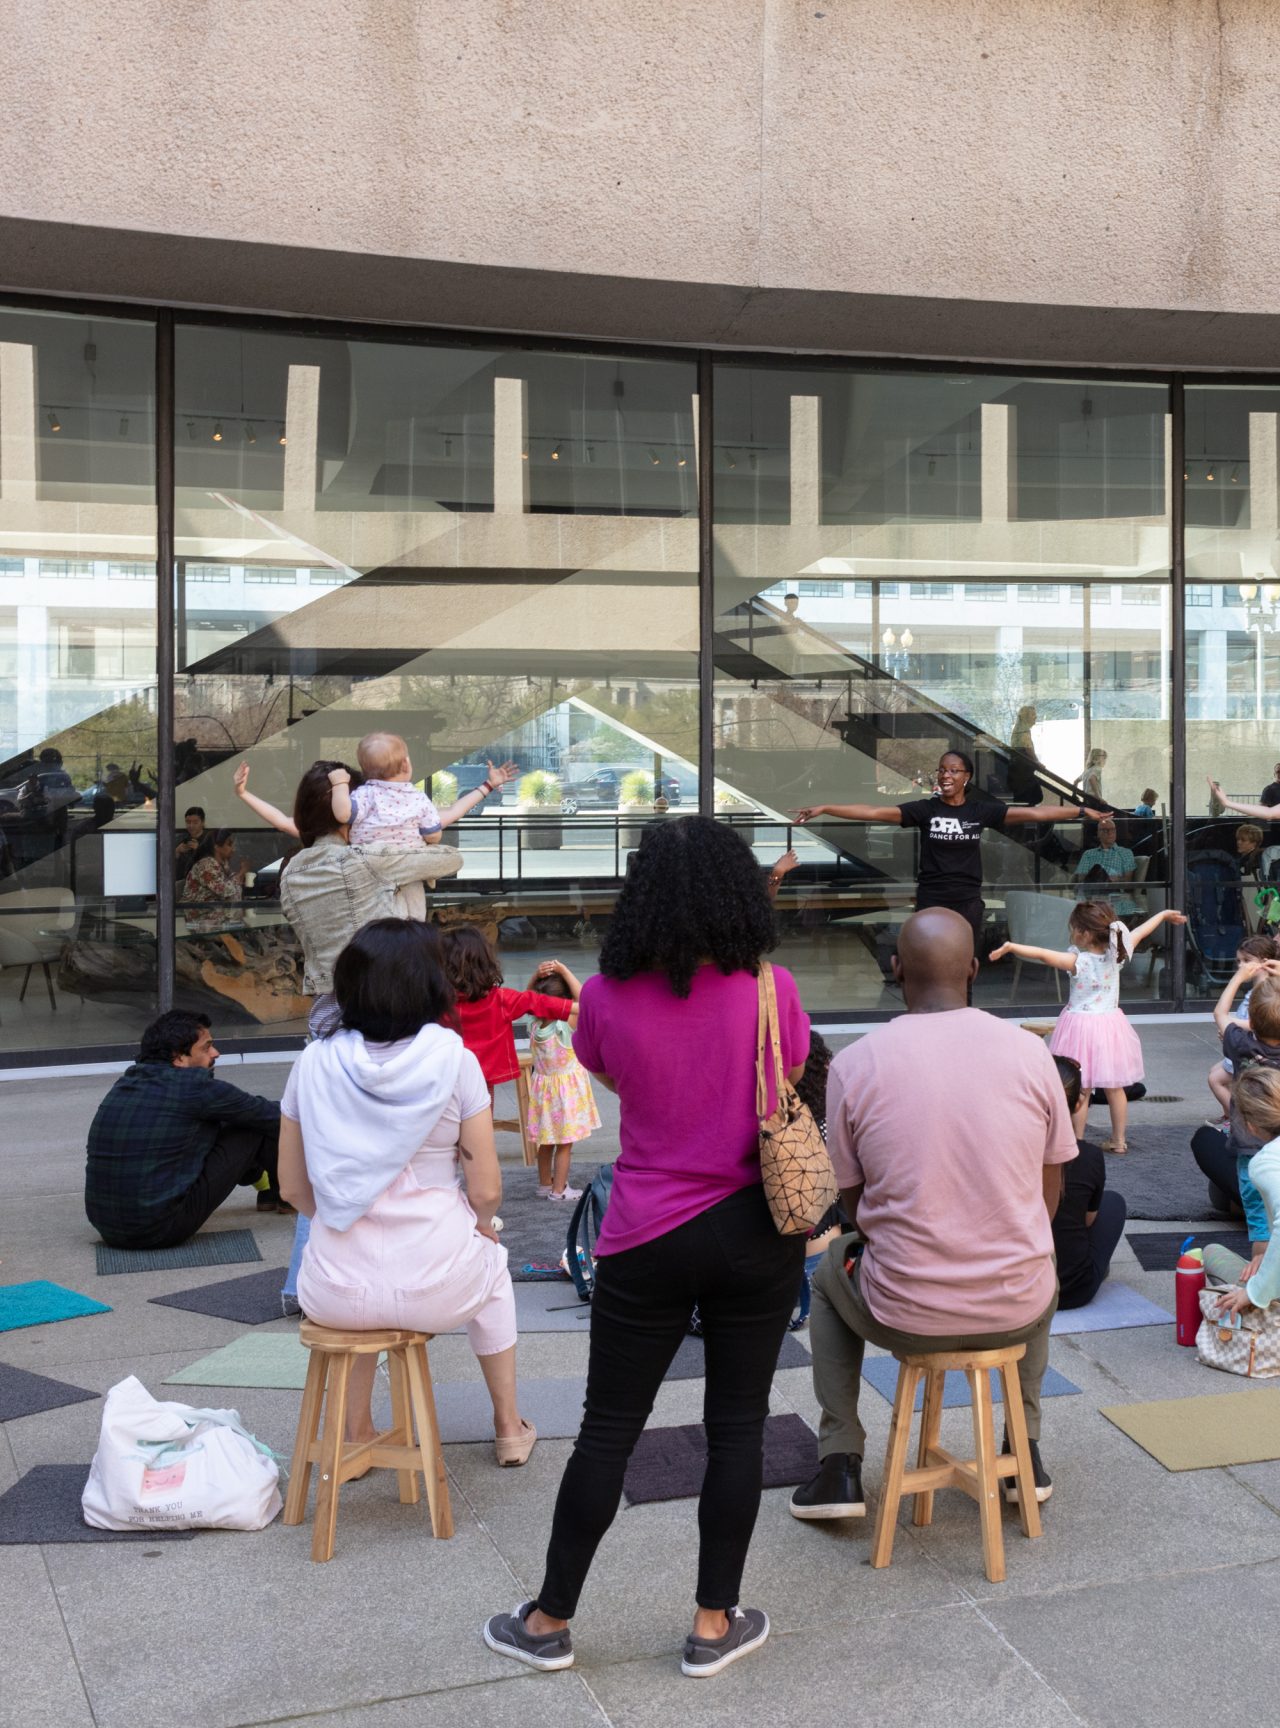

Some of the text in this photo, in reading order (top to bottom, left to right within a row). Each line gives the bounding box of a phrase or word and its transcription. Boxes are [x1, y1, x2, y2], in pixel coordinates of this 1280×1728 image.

[930, 816, 964, 834] DFA
[929, 832, 953, 840] DANCE
[165, 1501, 182, 1511] YOU
[128, 1515, 144, 1523] FOR
[190, 1510, 203, 1519] ME
